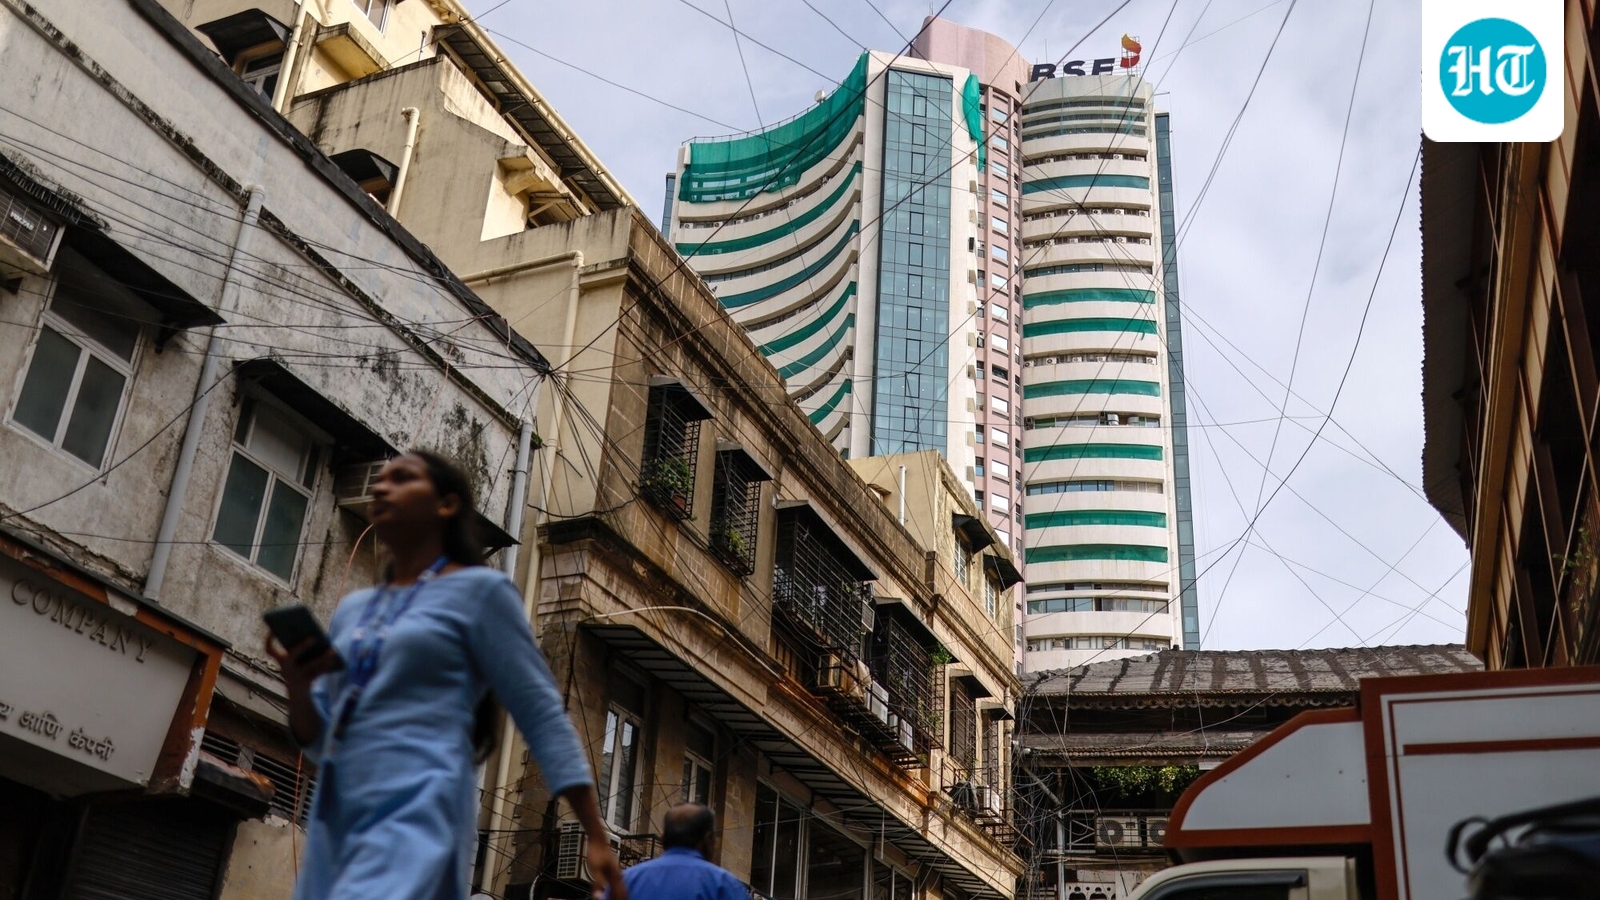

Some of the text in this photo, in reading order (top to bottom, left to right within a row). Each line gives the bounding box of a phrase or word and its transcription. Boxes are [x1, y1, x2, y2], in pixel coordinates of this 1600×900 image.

[11, 578, 154, 663] COMPANY
[18, 709, 63, 740] आणि
[67, 727, 115, 761] कंपनी
